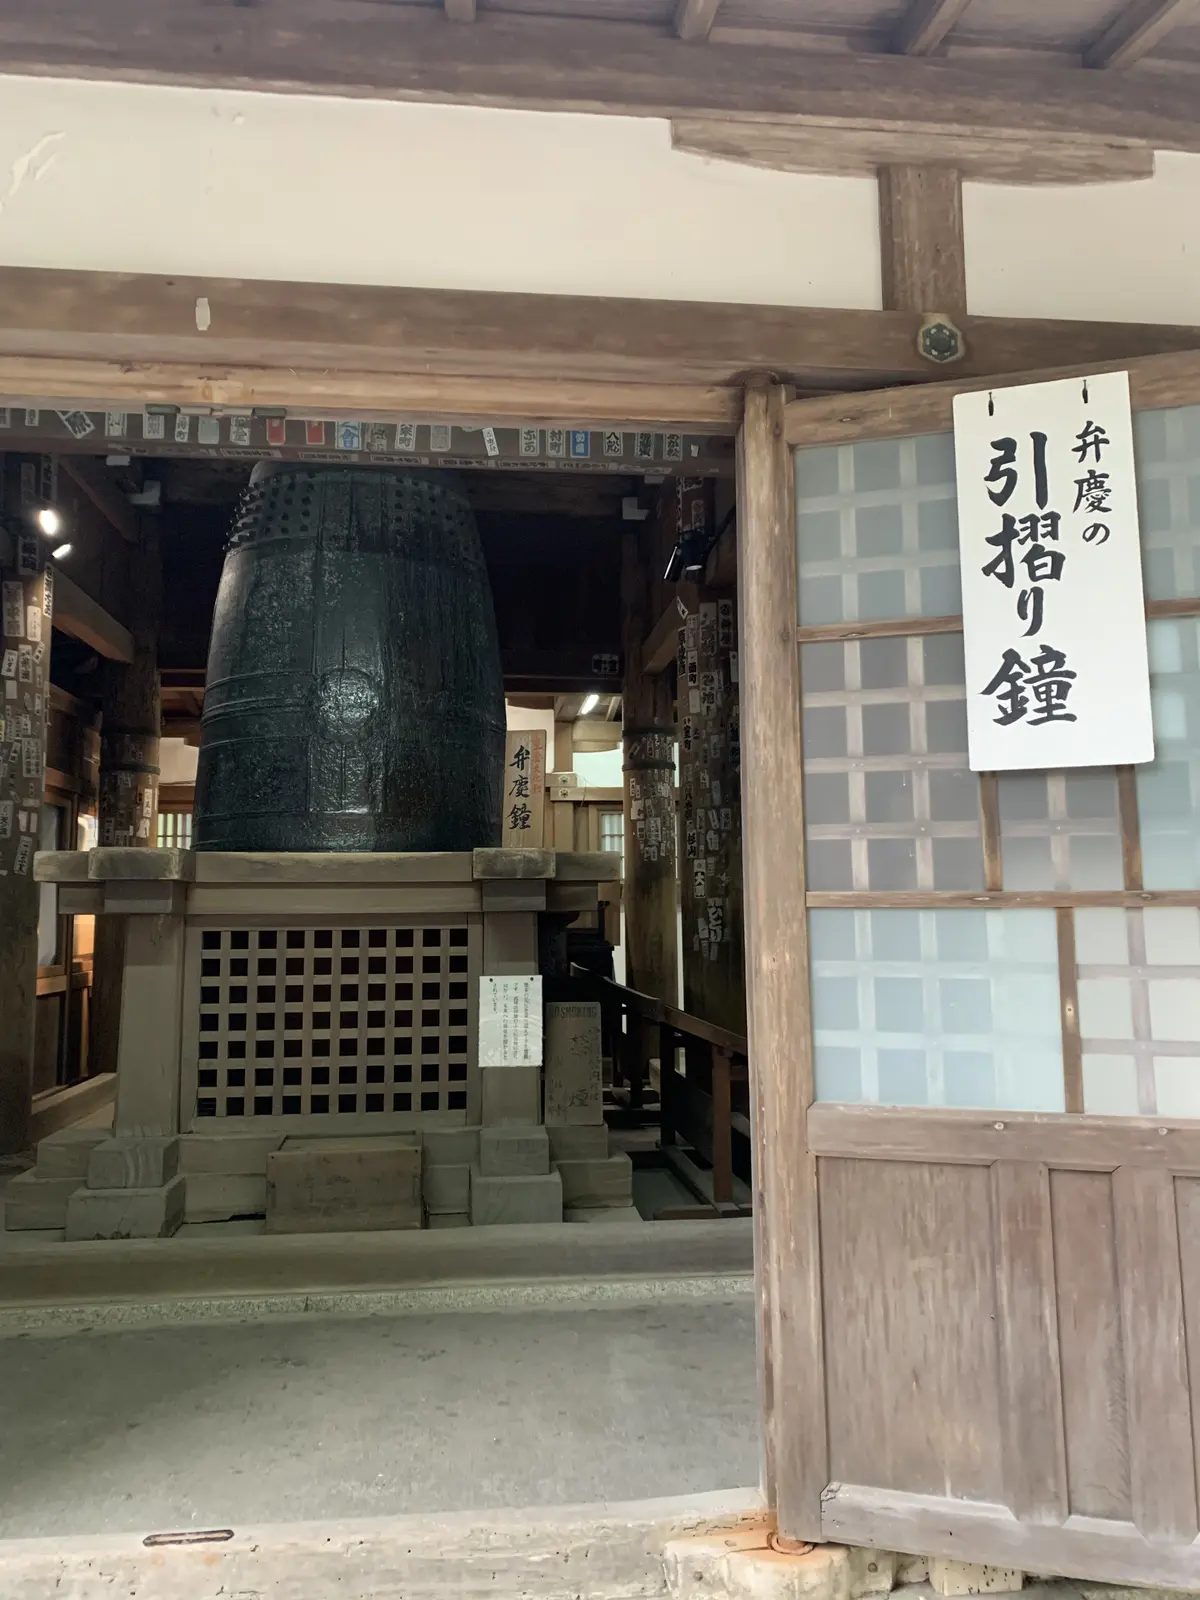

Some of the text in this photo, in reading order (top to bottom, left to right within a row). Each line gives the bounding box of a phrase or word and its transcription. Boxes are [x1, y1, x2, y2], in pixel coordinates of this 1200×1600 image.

[1071, 420, 1113, 546] 弁慶の
[979, 431, 1078, 727] 引摺り鐘
[506, 744, 533, 830] 弁慶鐘
